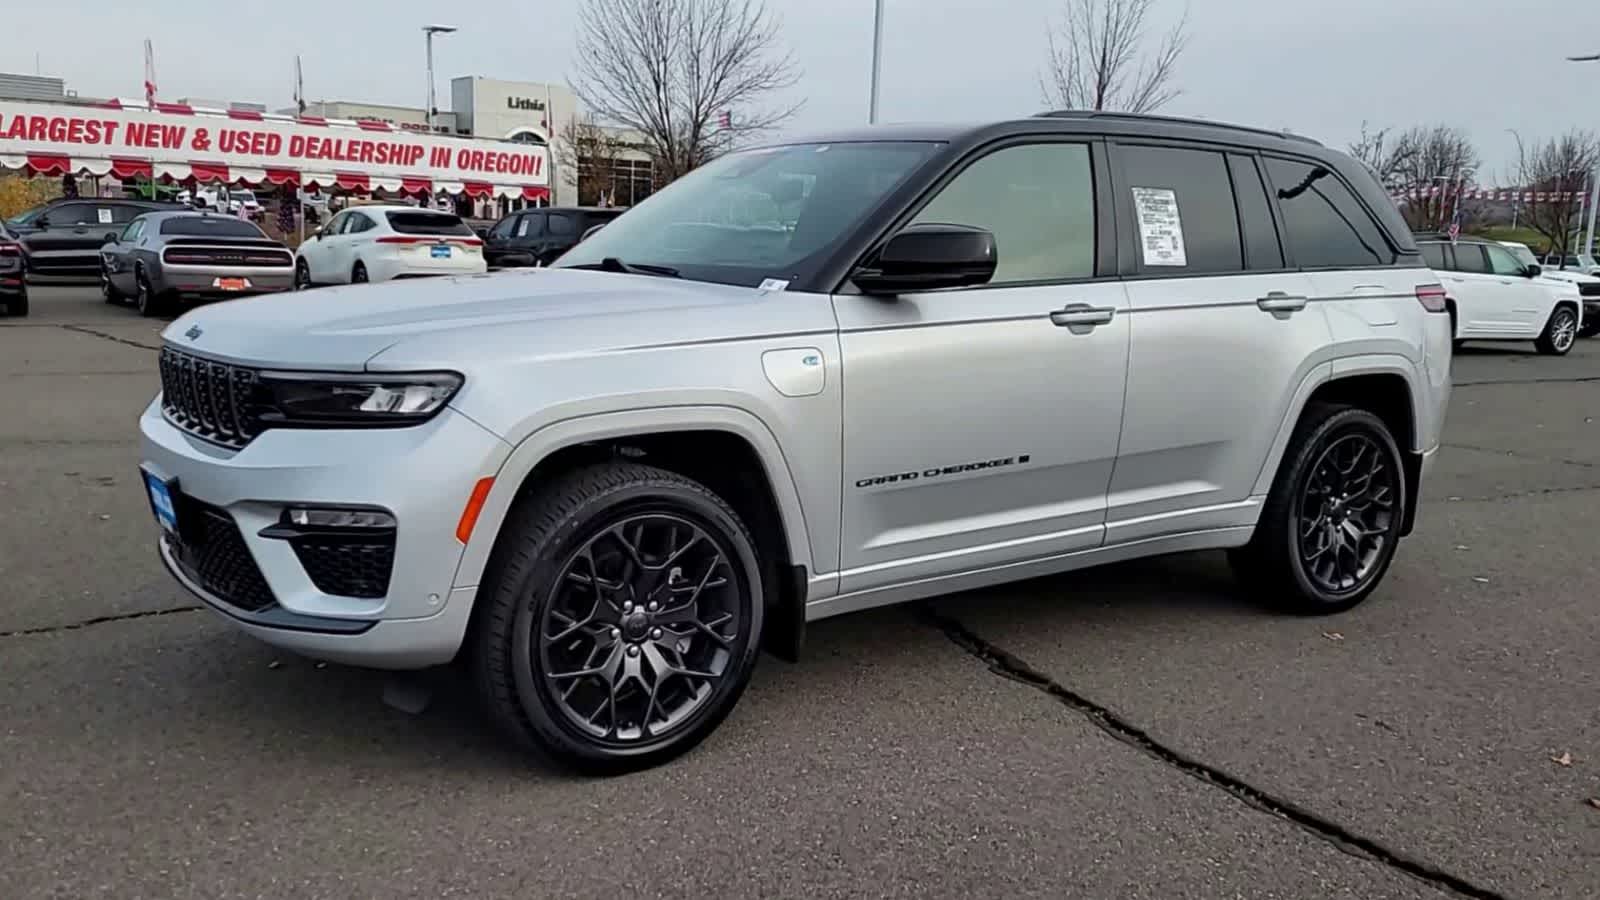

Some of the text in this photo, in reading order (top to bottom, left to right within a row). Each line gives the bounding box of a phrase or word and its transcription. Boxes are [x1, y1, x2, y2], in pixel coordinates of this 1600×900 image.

[507, 96, 545, 111] Lithia
[125, 122, 186, 149] NEW
[191, 128, 211, 151] &
[218, 129, 282, 156] USED
[288, 135, 425, 166] DEALERSHIP
[430, 146, 452, 168] IN
[457, 149, 542, 176] OREGON!
[856, 457, 1014, 488] GRAND CHEROKEE
